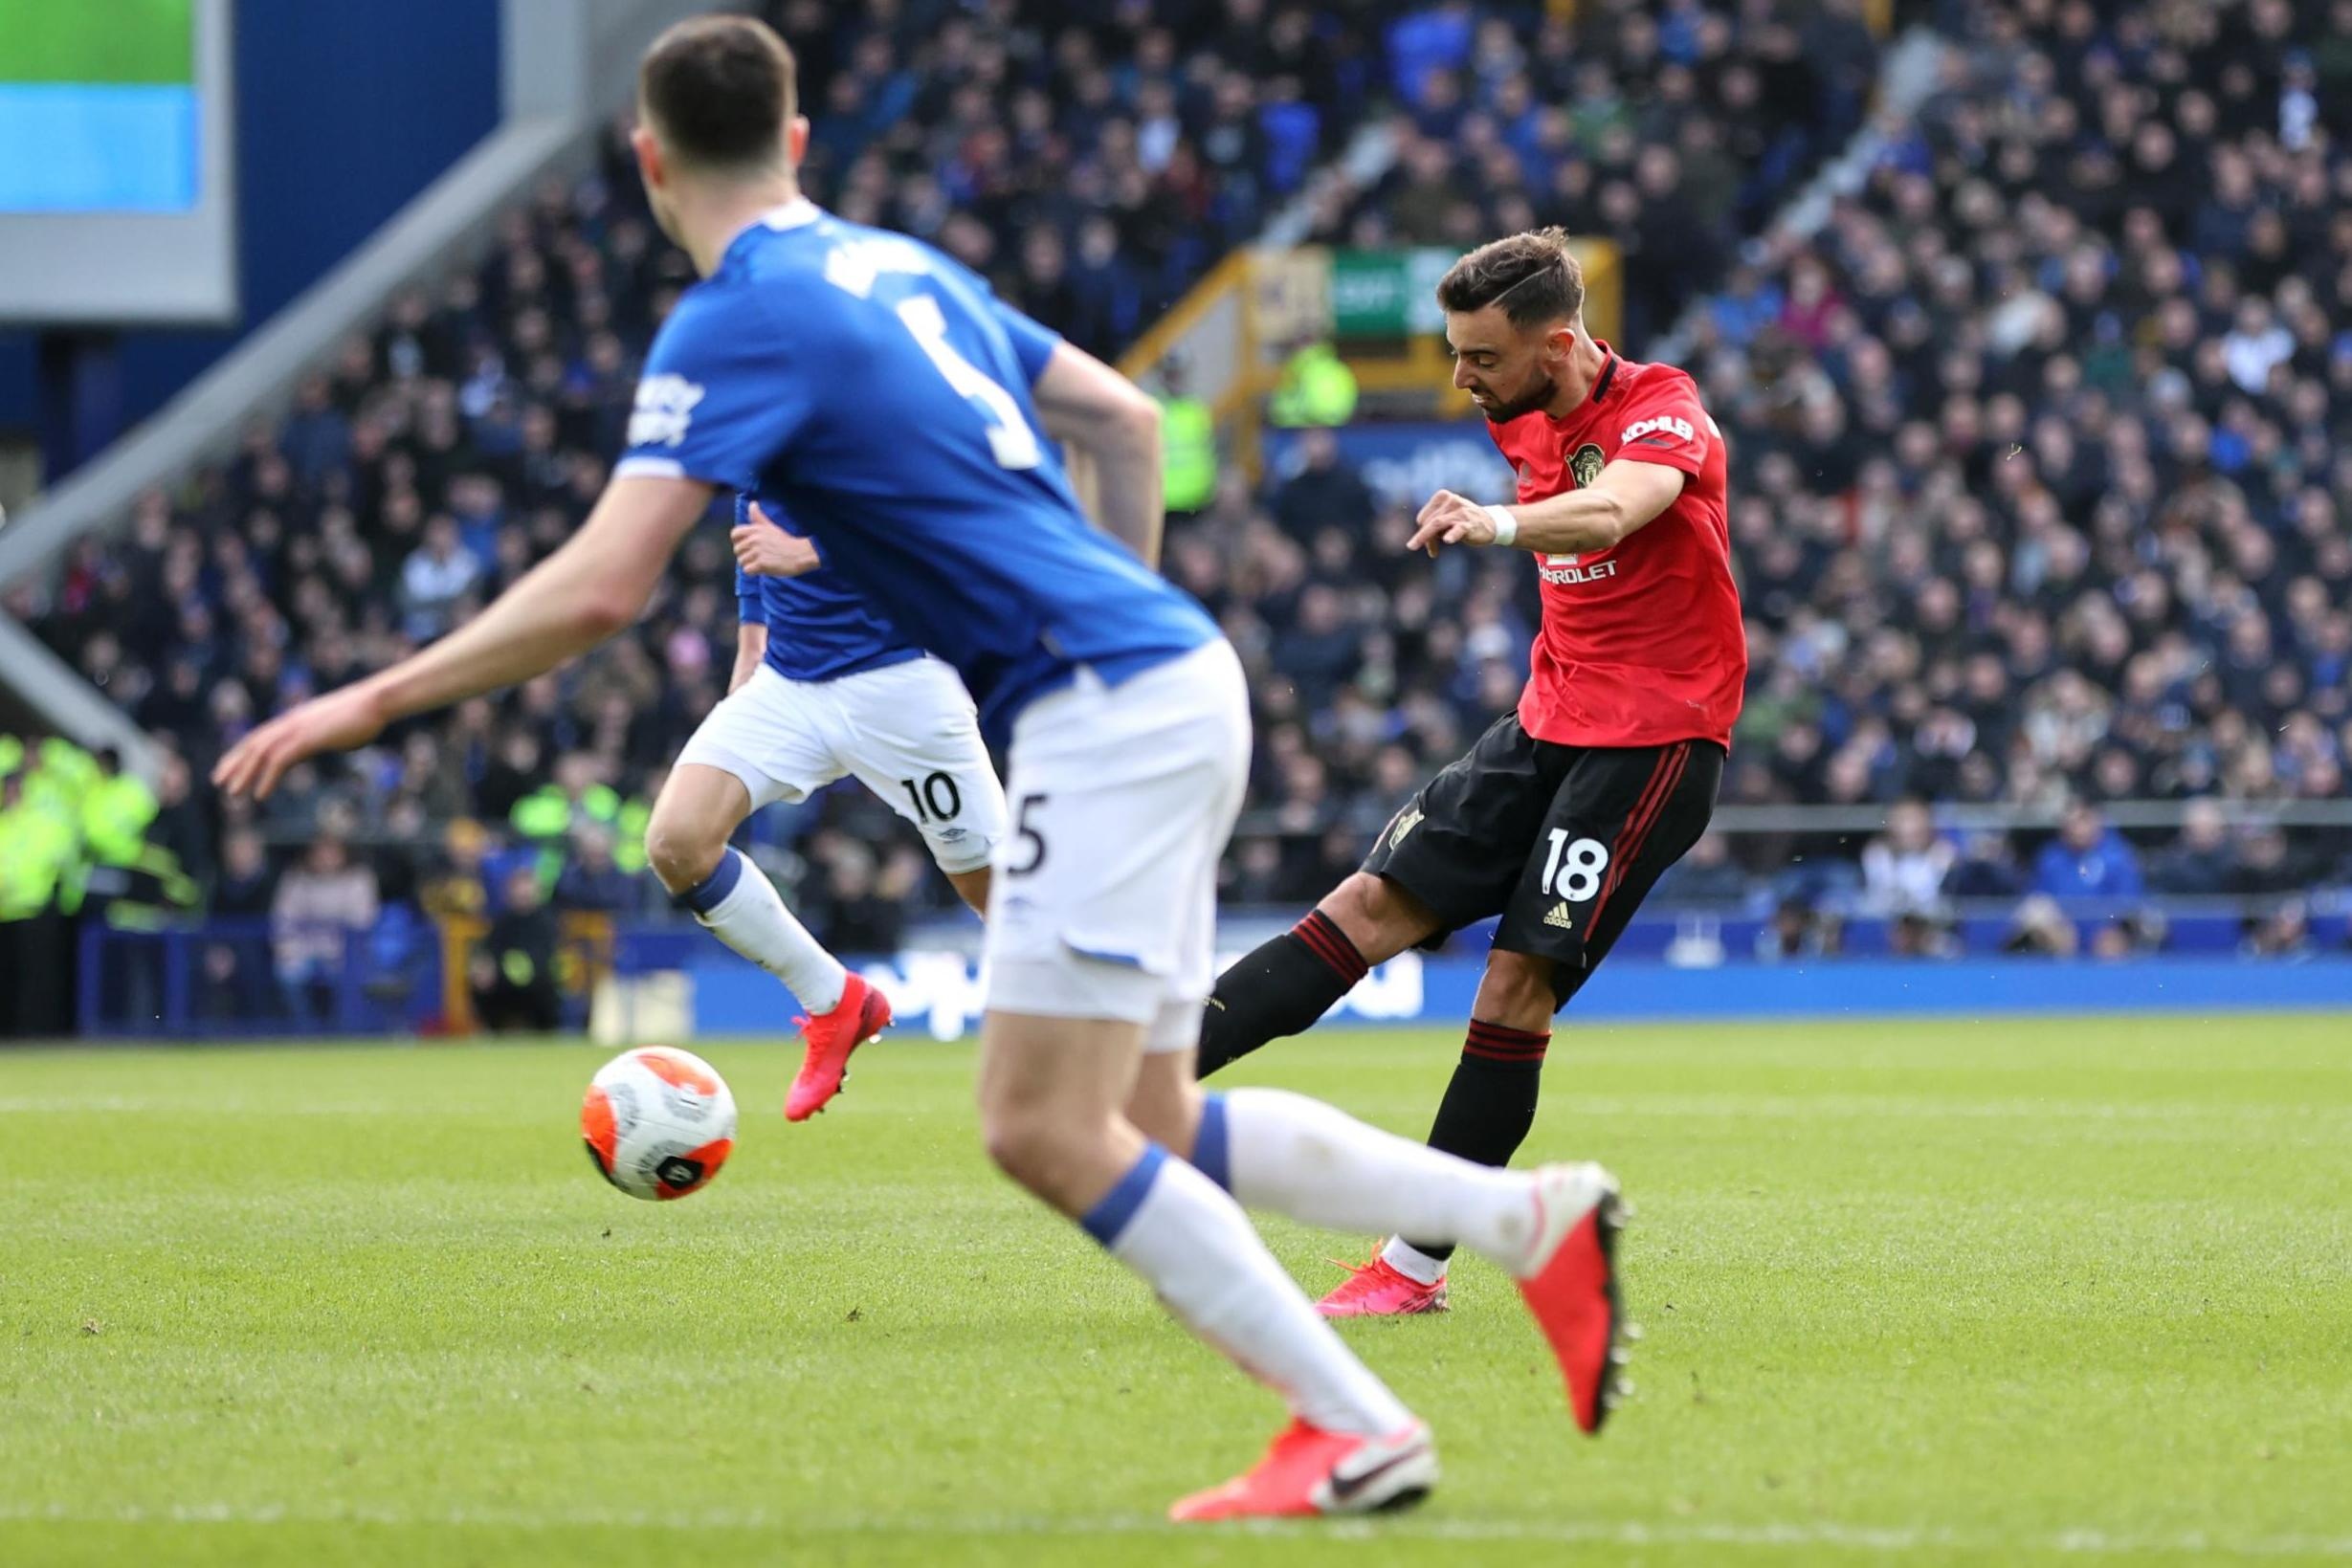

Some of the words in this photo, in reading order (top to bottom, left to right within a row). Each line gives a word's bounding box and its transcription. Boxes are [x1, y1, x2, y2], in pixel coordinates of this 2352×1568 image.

[900, 771, 961, 824] 10
[1008, 793, 1050, 877] 5
[1542, 827, 1609, 902] 18
